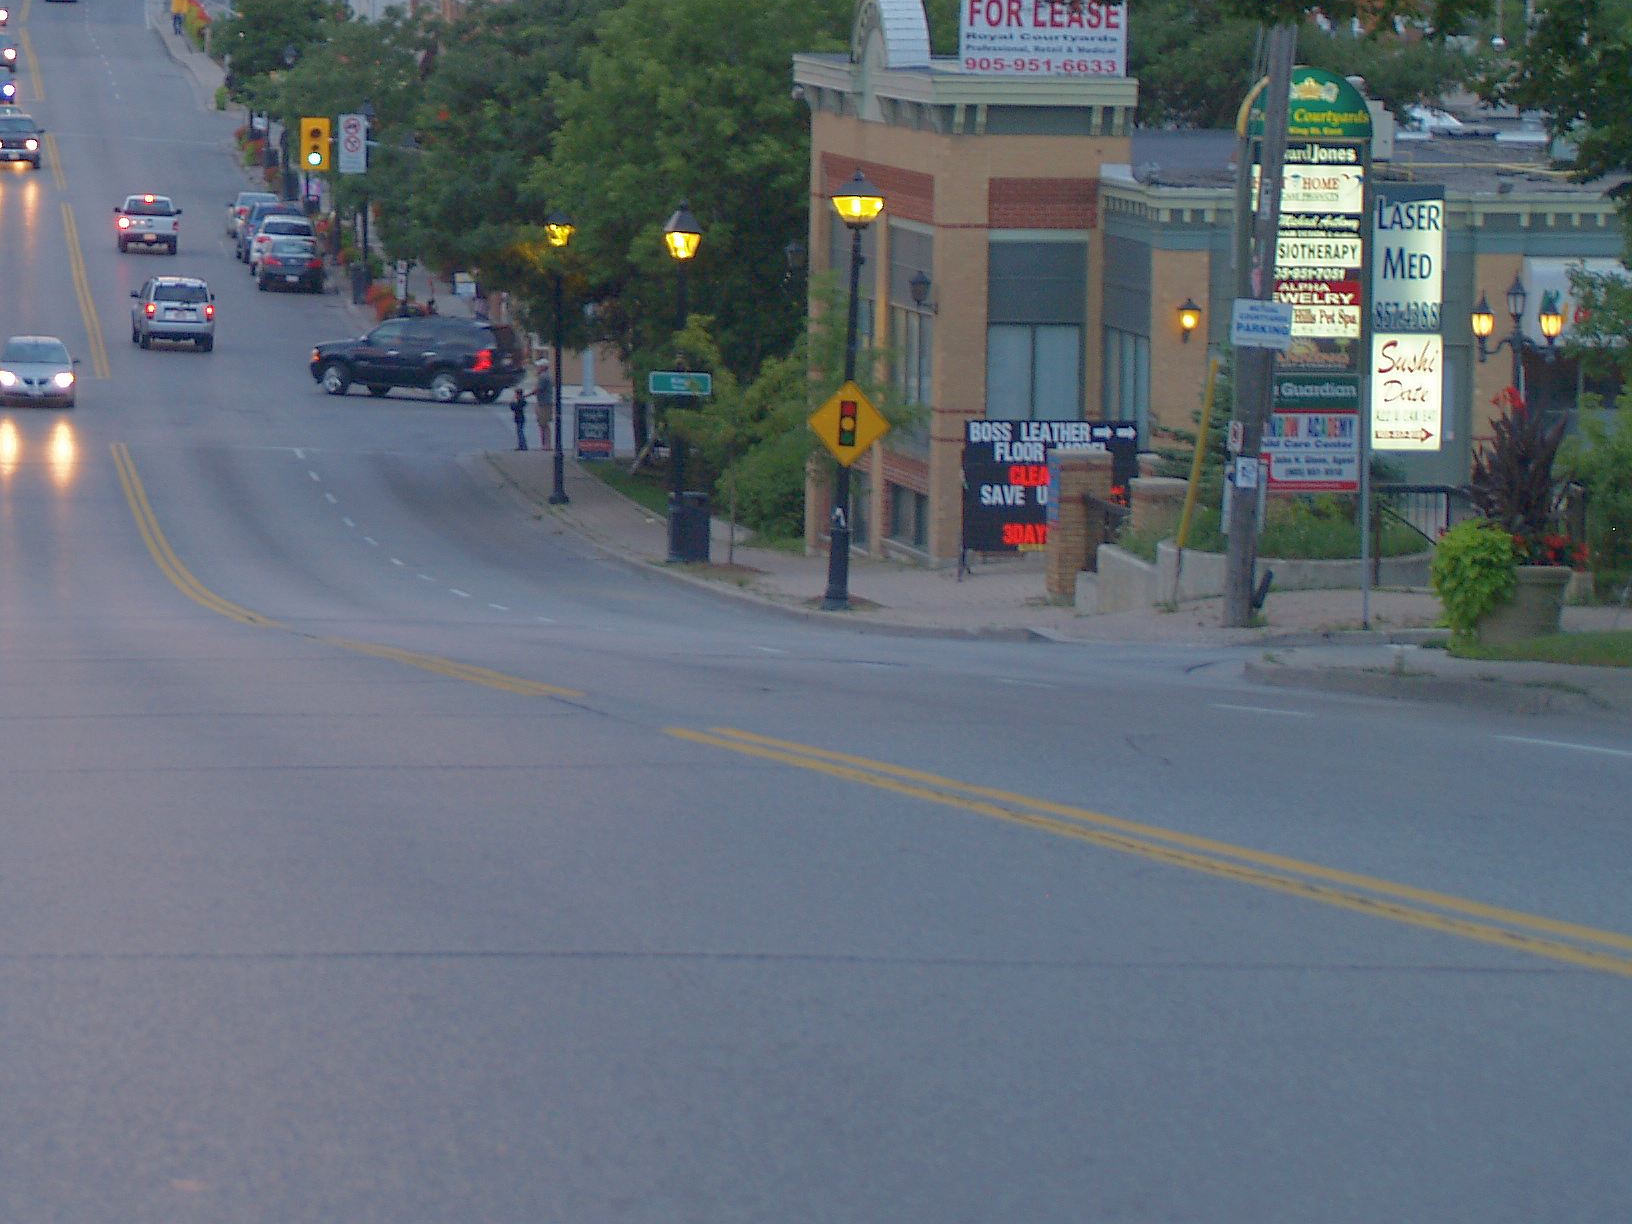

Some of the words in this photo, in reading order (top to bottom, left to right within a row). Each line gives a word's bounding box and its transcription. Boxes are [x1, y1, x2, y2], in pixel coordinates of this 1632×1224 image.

[964, 58, 1116, 72] 905-951-6633
[1302, 177, 1340, 190] HOME
[1378, 198, 1440, 230] LASER
[1383, 247, 1432, 279] MED
[1278, 282, 1331, 292] ALPHA
[1236, 321, 1289, 336] PARKING
[1378, 340, 1439, 373] Sushi
[1280, 382, 1357, 397] Guardian
[1383, 380, 1429, 402] Date
[970, 421, 1012, 442] BOSS
[1020, 421, 1091, 442] LEATHER
[994, 441, 1045, 463] FLOOR
[980, 483, 1026, 506] SAVE
